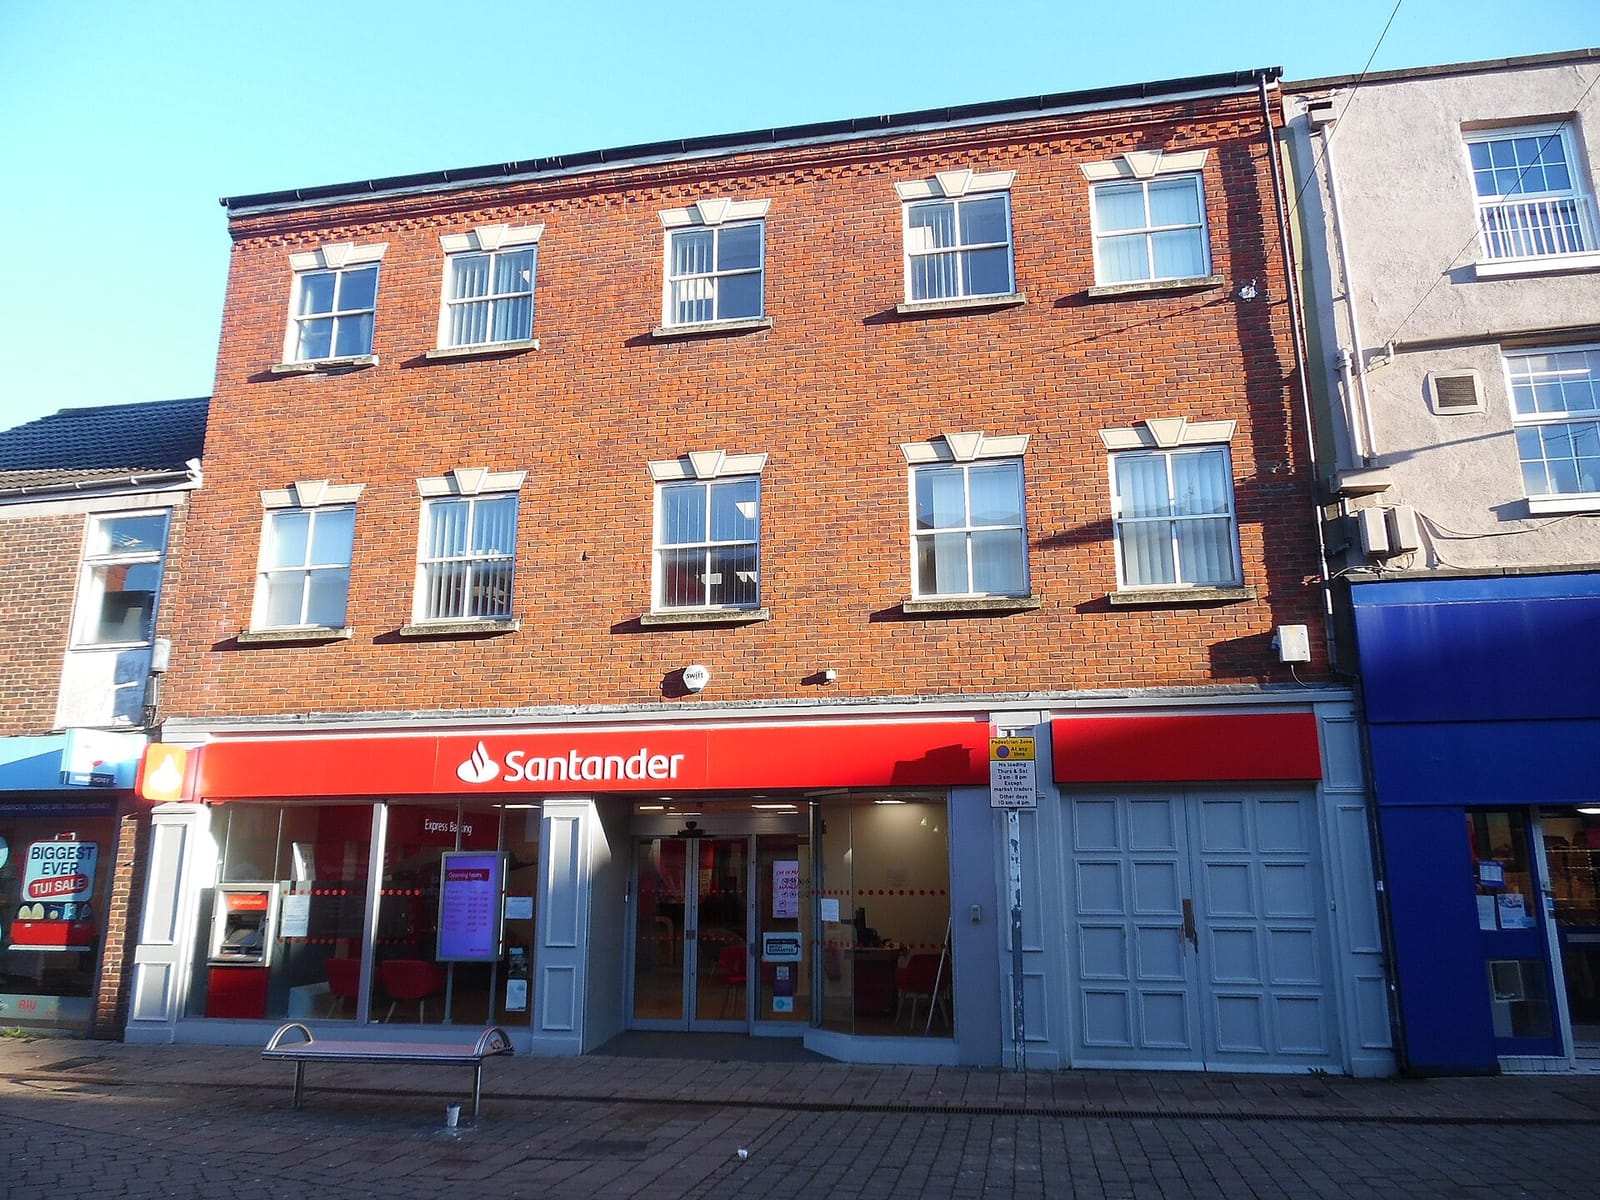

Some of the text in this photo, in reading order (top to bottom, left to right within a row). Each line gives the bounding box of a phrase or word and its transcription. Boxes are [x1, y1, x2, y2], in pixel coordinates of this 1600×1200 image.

[503, 748, 684, 783] Santander
[424, 818, 473, 837] Express Baing
[31, 846, 96, 860] BIGGEST
[41, 861, 79, 875] EVER
[32, 878, 84, 895] TUI SALE
